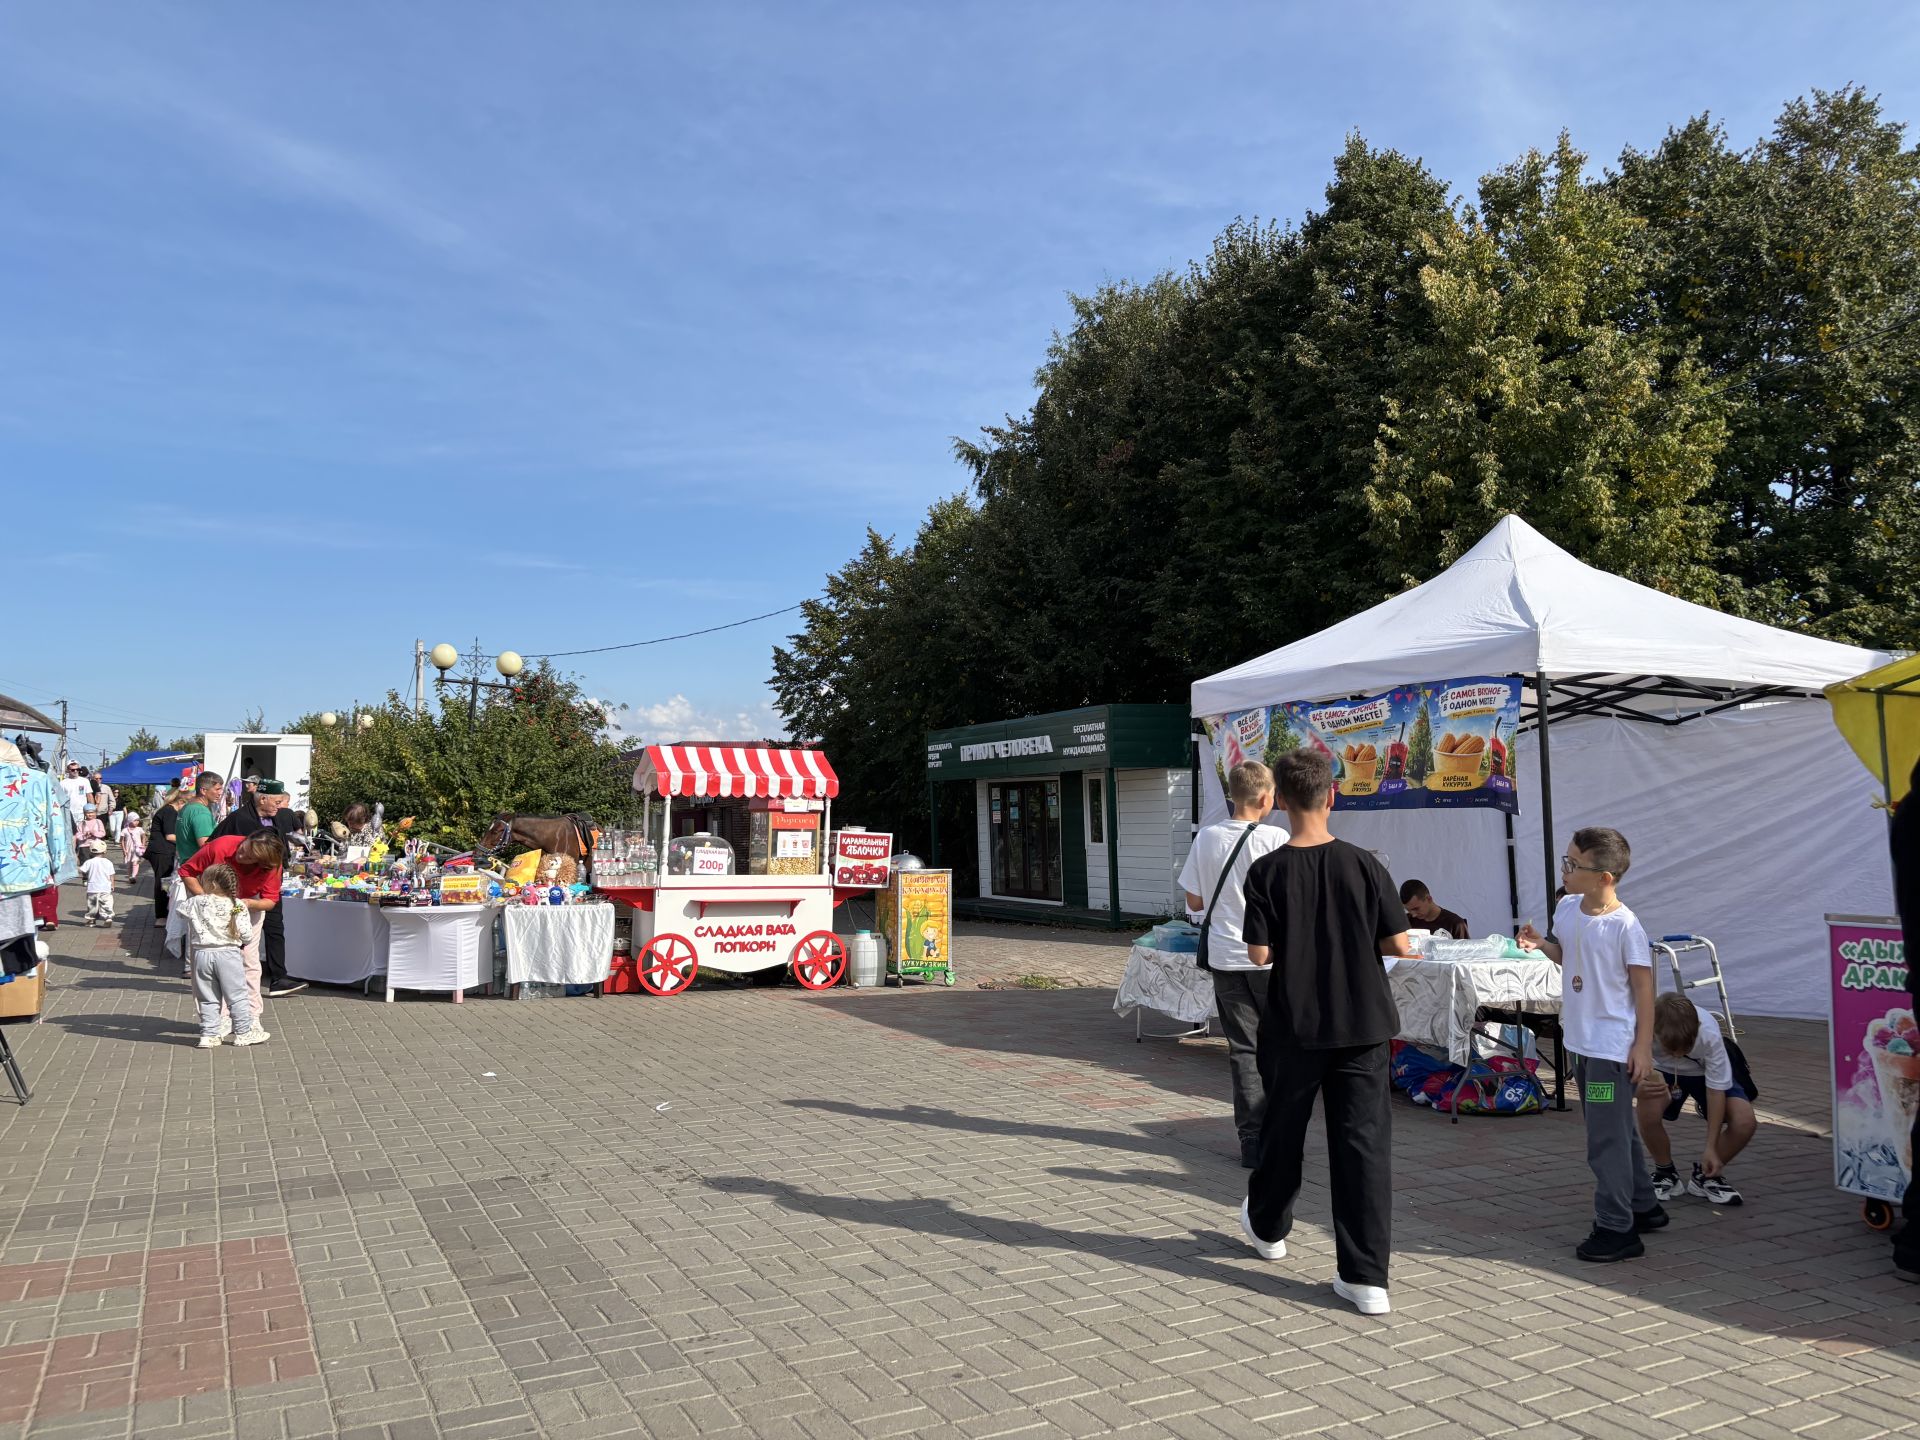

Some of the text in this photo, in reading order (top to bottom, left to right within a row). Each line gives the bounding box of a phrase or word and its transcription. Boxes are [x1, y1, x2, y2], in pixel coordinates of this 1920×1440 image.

[1450, 689, 1476, 700] САМОЕ
[1449, 700, 1478, 710] ОДНОМ
[1324, 711, 1347, 719] САМОЕ
[1328, 718, 1352, 729] ОДНОМ
[1353, 709, 1383, 723] МЕСТЕ!
[1073, 722, 1105, 733] БЕСПЛАТНАЯ
[1080, 733, 1105, 743] ПОМОЩЬ
[1063, 743, 1106, 756] НУЖДАЮЩИМСЯ
[841, 837, 889, 846] КАРАМЕЛЬНЫЕ
[846, 845, 884, 856] ЯБЛОЧКИ
[699, 860, 724, 872] 200р
[694, 923, 796, 939] СЛАДКАЯ ВАТА
[714, 940, 776, 954] ПОПКОРН
[902, 960, 947, 968] КУКУРУЗКИН
[1588, 1085, 1611, 1098] SPORT
